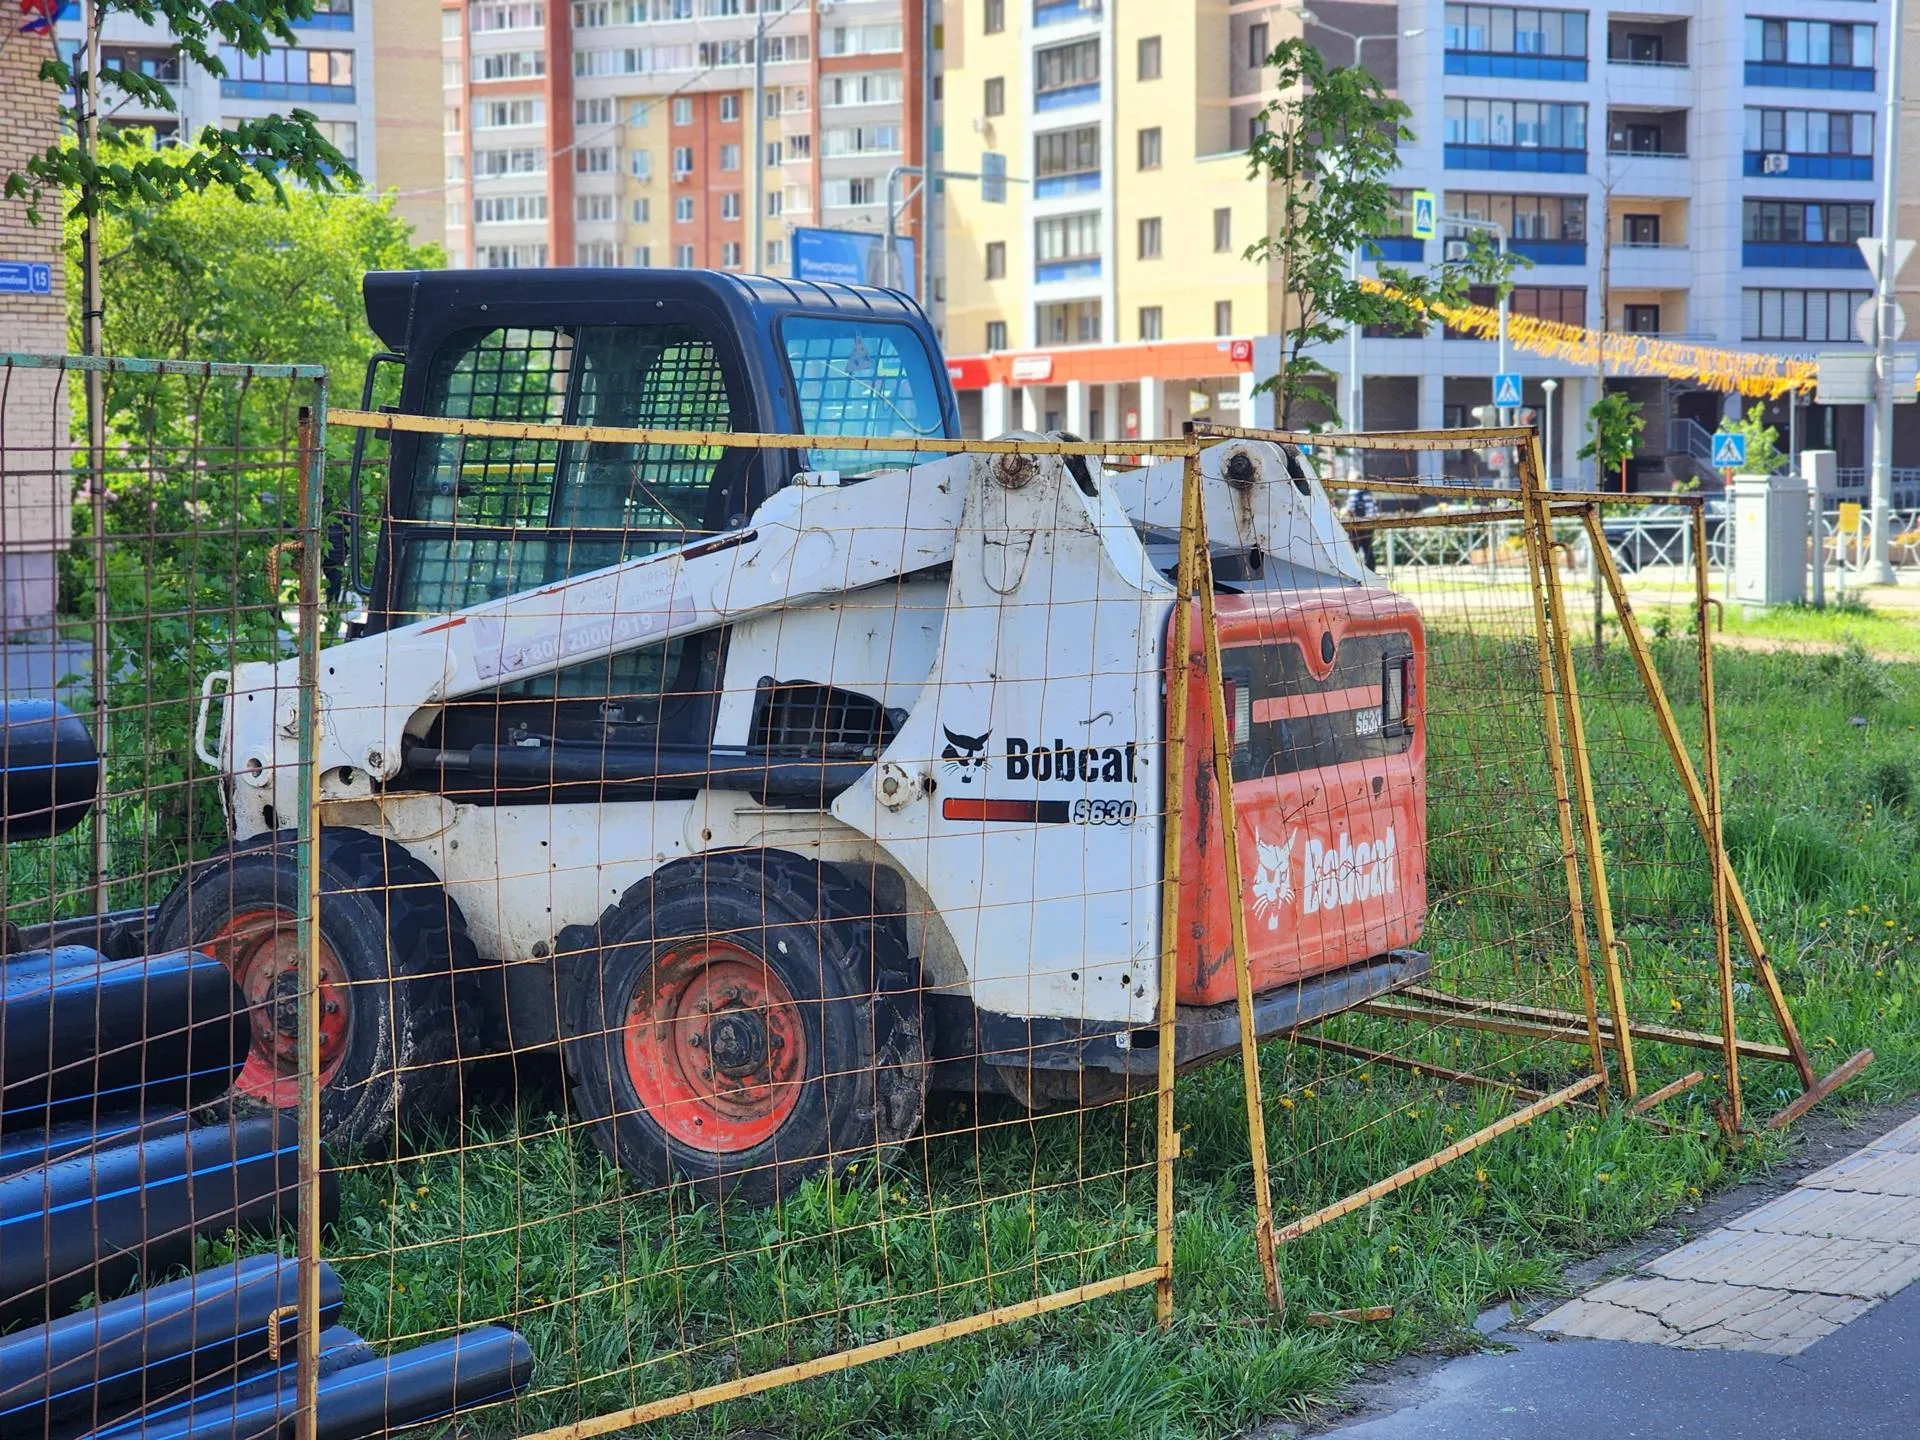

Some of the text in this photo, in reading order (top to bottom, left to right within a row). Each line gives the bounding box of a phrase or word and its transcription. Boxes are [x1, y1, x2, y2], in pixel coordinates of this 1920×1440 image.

[35, 271, 47, 287] 15
[1006, 738, 1138, 783] Bobcat
[1073, 799, 1138, 826] S630
[1304, 826, 1396, 915] Bobcat
